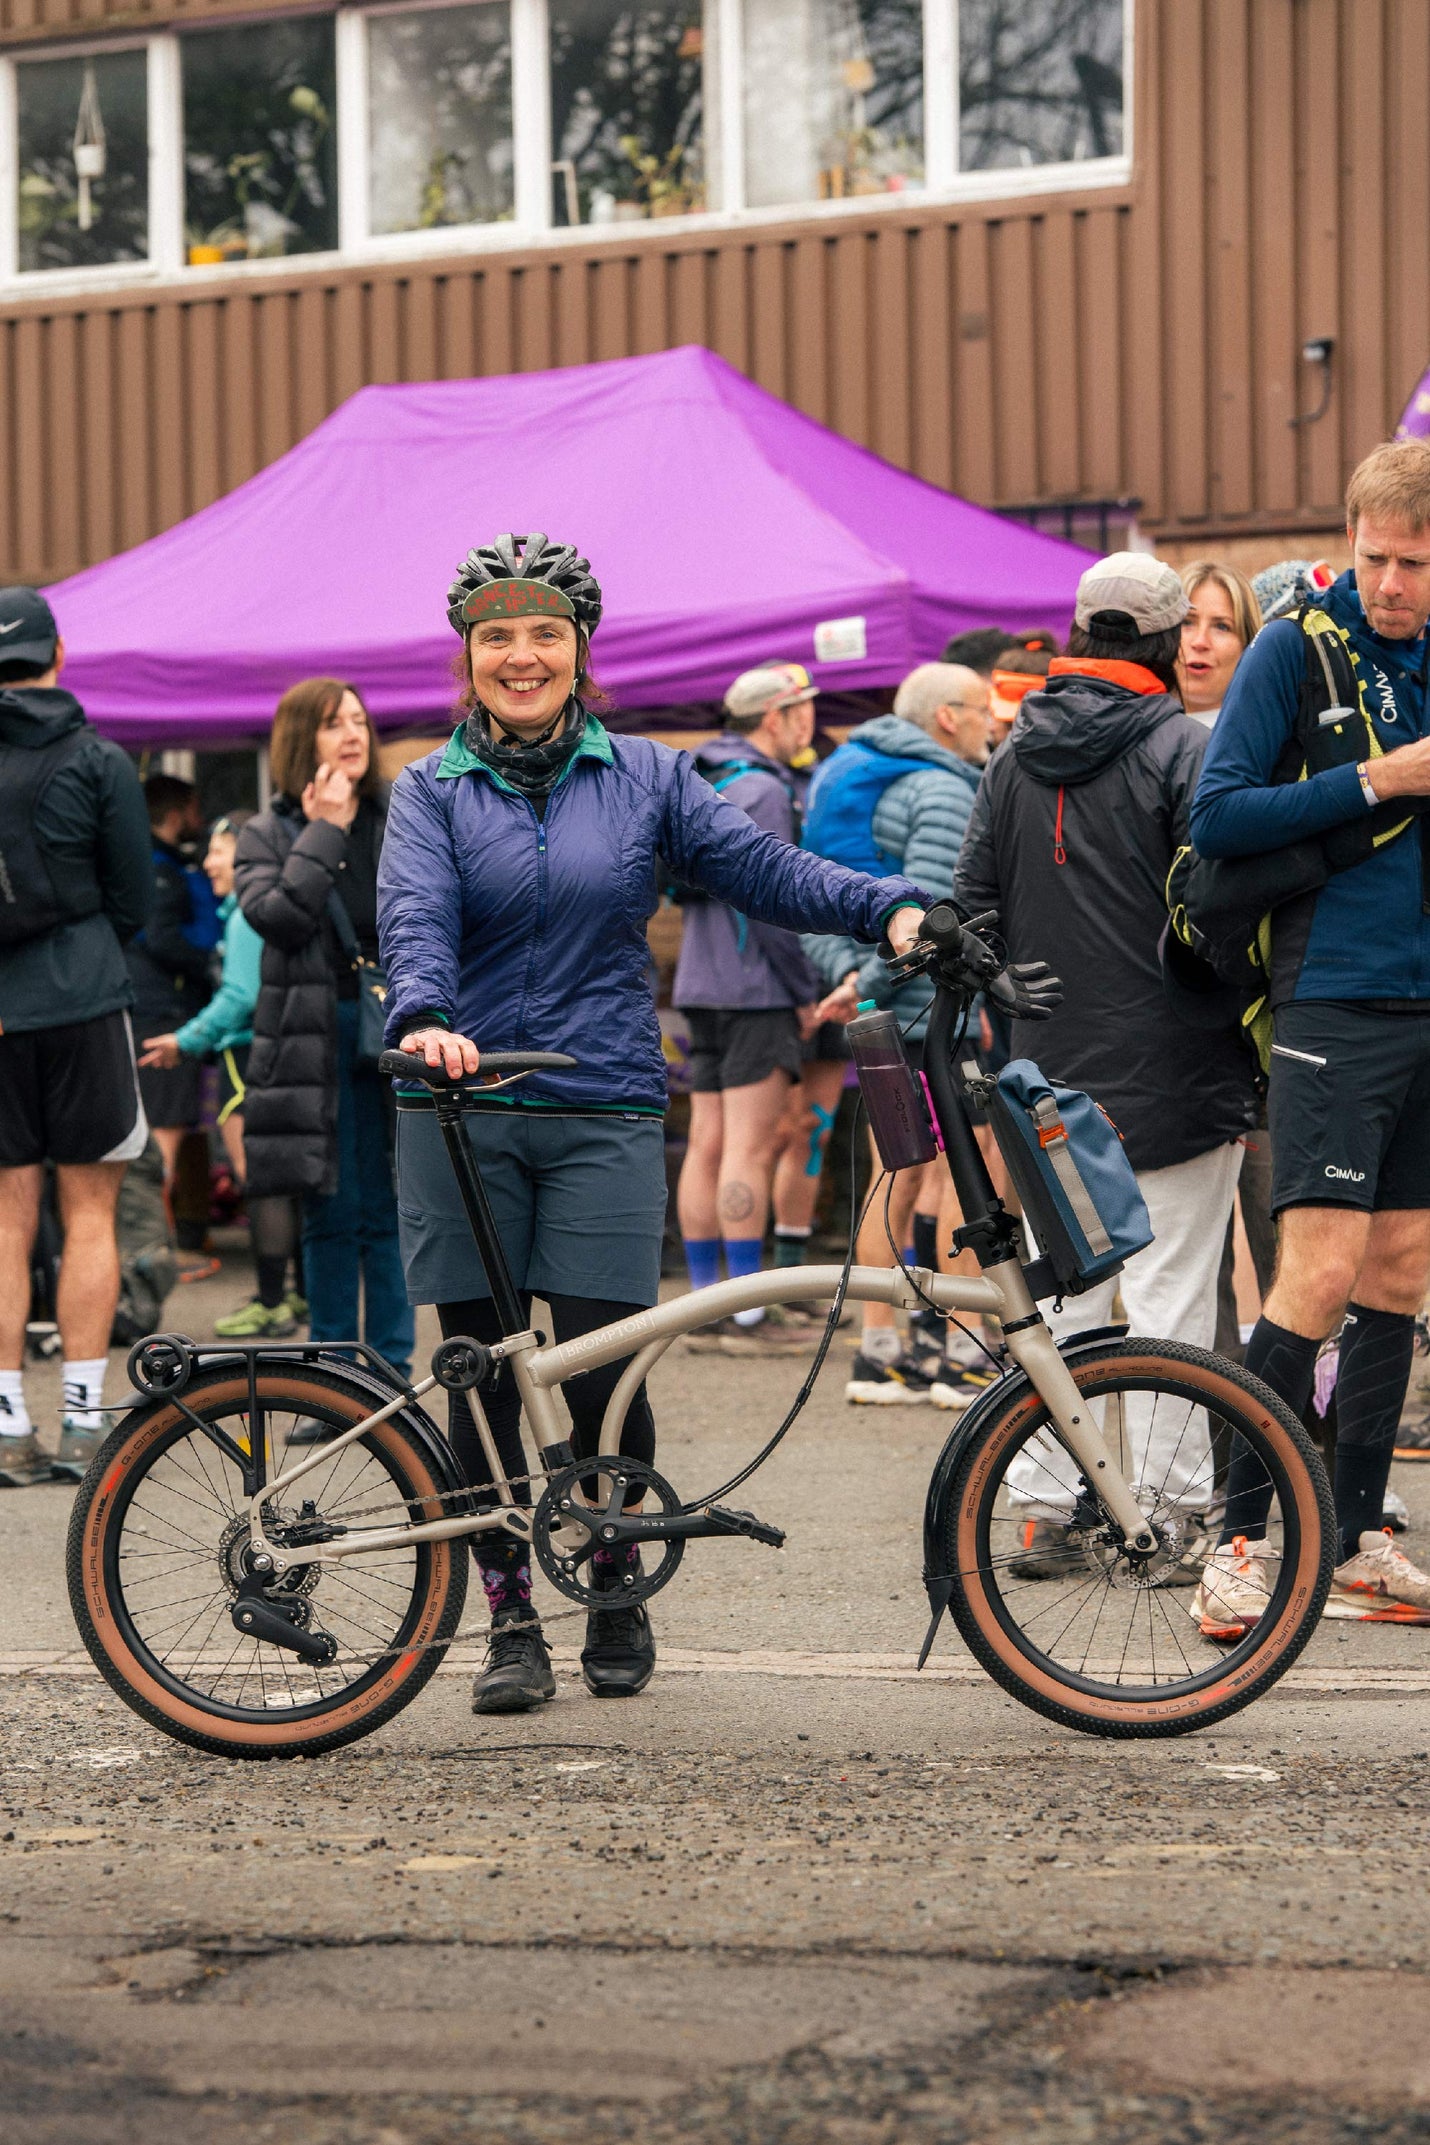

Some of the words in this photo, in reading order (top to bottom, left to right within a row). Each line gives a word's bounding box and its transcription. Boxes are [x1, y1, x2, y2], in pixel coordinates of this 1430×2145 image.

[566, 1315, 648, 1357] BROMPTON
[965, 1431, 1008, 1519] SCHWALBE
[90, 1524, 105, 1619] SCHWALBE
[425, 1541, 442, 1622] CHWALBE
[1255, 1586, 1307, 1669] SCHWALBE
